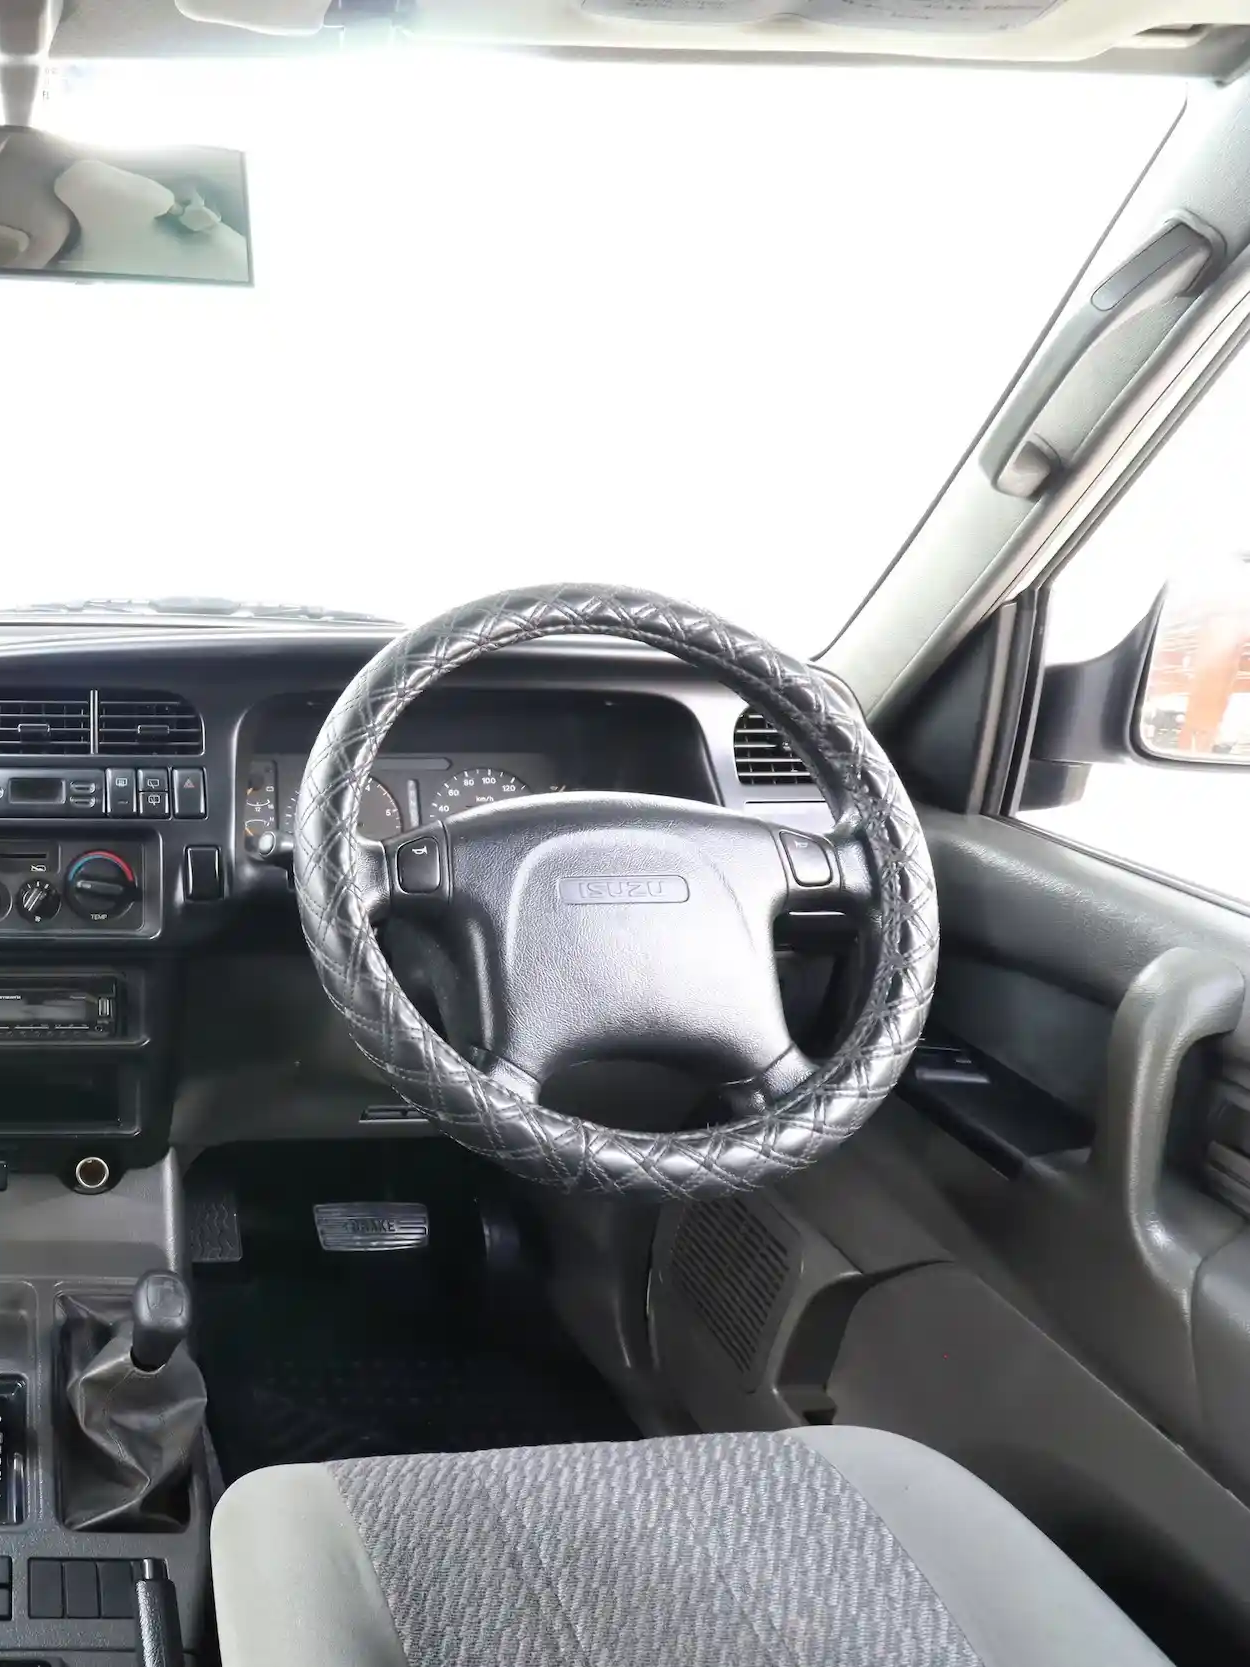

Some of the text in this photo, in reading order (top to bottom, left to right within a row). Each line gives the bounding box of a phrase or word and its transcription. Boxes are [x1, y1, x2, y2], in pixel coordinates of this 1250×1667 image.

[463, 778, 475, 787] 80
[482, 777, 496, 785] 100
[502, 784, 516, 793] 120
[448, 789, 460, 797] 60
[476, 795, 494, 803] km/h
[438, 805, 450, 813] 40
[578, 880, 666, 899] ISUZU
[90, 913, 108, 921] TEMP
